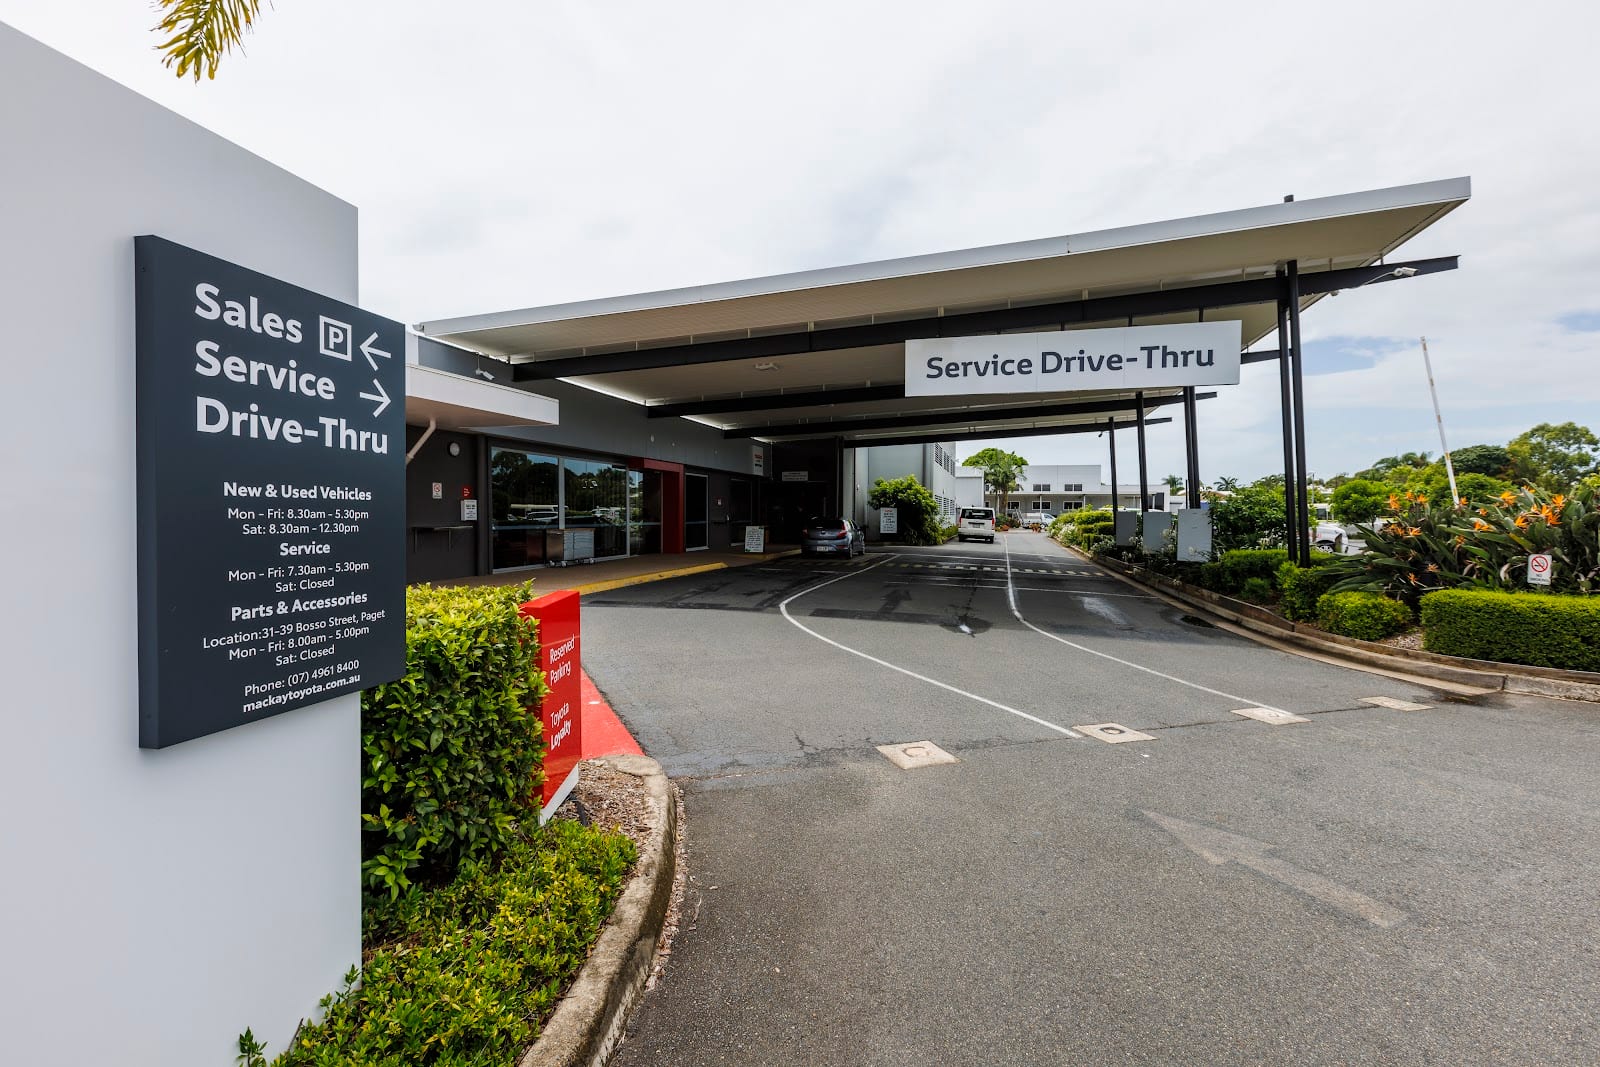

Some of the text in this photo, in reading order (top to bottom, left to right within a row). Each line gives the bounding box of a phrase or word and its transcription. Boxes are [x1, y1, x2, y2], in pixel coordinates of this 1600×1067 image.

[195, 283, 303, 344] Sales
[195, 340, 336, 400] Service
[927, 345, 1215, 380] Service Drive-Thru
[197, 396, 388, 454] Drive-Thru
[224, 482, 372, 501] New & Used Vehicles
[228, 508, 255, 520] Mon
[267, 509, 285, 519] Fri:
[287, 509, 326, 519] 8.30am
[335, 509, 369, 520] 5.30pm
[242, 524, 266, 535] Sat:
[269, 524, 309, 534] 8.30am
[319, 523, 359, 535] 12.30pm
[280, 541, 331, 556] Service
[228, 570, 256, 582] Mon
[268, 568, 285, 578] Fri:
[288, 566, 326, 577] 7.30am
[335, 562, 369, 574] 5.30pm
[275, 577, 335, 593] Sat: Closed
[231, 592, 368, 621] Parts & Accessories
[296, 620, 327, 631] Bosso
[329, 613, 359, 627] Street,
[361, 609, 385, 621] Paget
[229, 646, 256, 660] Mon
[269, 641, 285, 653] Fri:
[288, 634, 326, 649] 8.00am
[336, 626, 370, 642] 5.00pm
[276, 645, 335, 666] Sat: Closed
[550, 633, 574, 664] Reserved
[245, 659, 359, 697] Phone: (07) 4961 8400
[550, 661, 571, 686] Parking
[243, 674, 361, 713] mackaytoyota.com.au
[550, 702, 569, 728] Toyota
[551, 720, 571, 750] Loyalty
